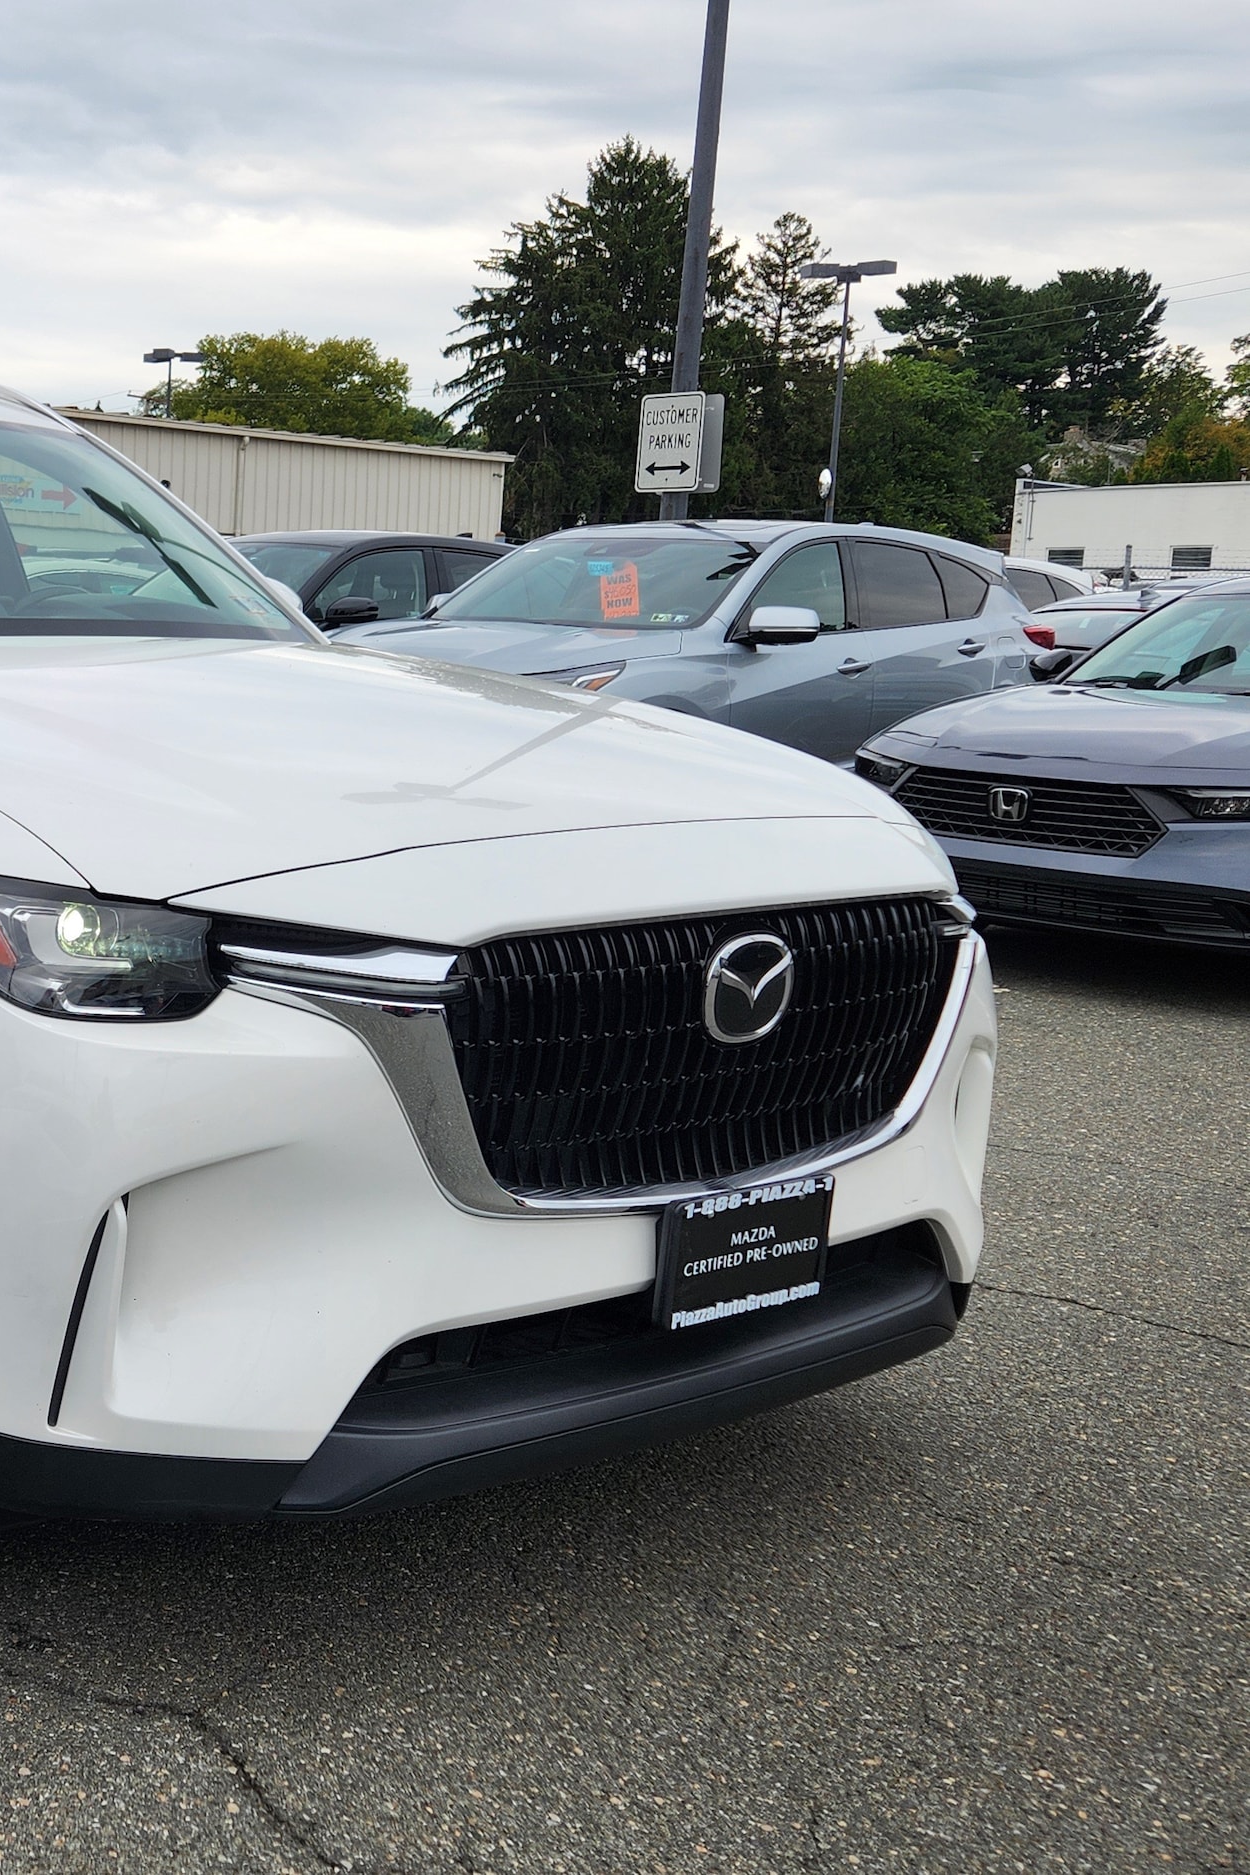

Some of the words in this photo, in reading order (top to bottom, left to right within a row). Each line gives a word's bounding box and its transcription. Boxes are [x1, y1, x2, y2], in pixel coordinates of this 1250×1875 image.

[646, 407, 699, 426] CUSTOMER
[648, 433, 692, 450] PARKING
[683, 1175, 835, 1219] 1-888-PIAZZA-1
[730, 1225, 776, 1248] MAZDA
[682, 1251, 744, 1278] CERTIFIED
[745, 1236, 819, 1264] PRE-OWNED
[670, 1281, 821, 1331] PiazzaAutoGroup.com
